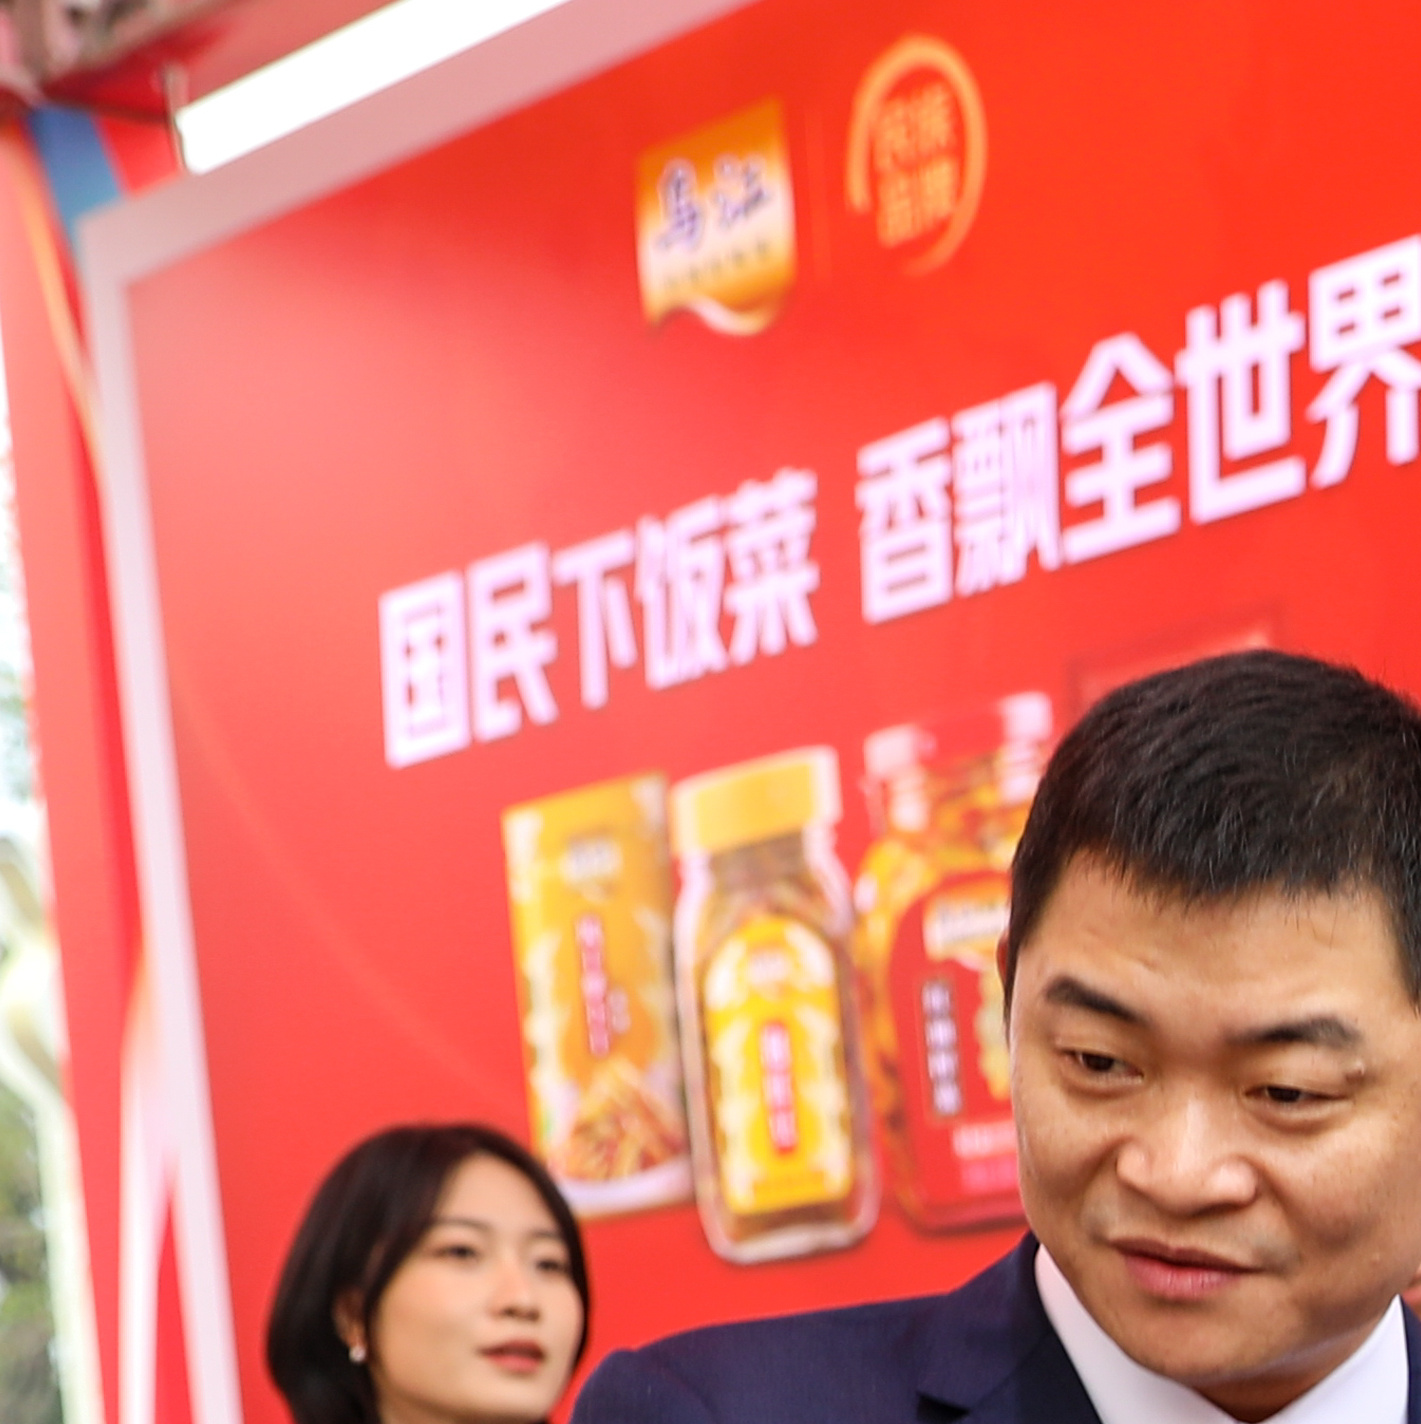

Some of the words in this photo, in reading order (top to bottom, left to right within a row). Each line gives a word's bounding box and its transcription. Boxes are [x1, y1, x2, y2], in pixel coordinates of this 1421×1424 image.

[378, 469, 818, 768] 国民下饭菜
